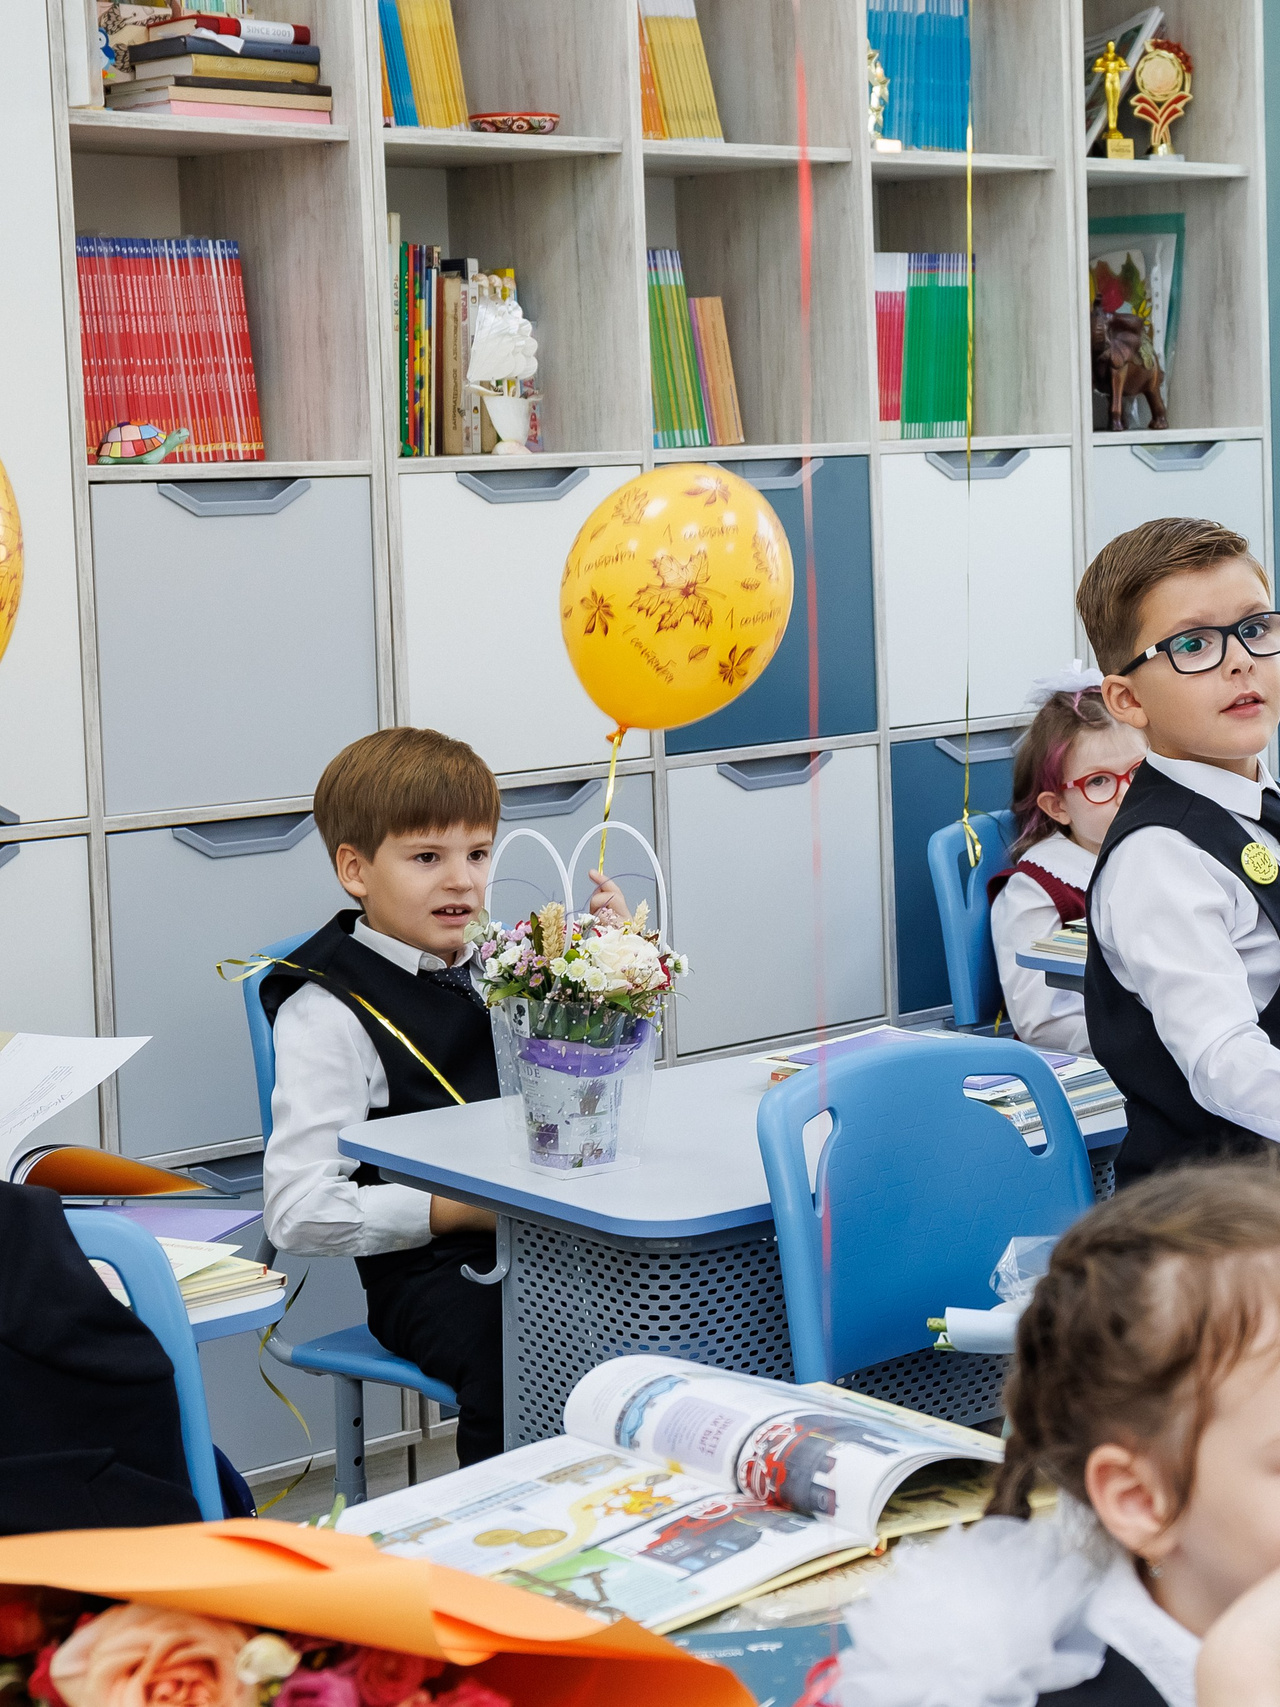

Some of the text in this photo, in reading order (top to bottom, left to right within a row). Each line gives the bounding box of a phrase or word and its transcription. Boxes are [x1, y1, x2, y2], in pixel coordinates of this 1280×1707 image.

[247, 26, 291, 38] SINCE 2001
[724, 607, 734, 631] 1
